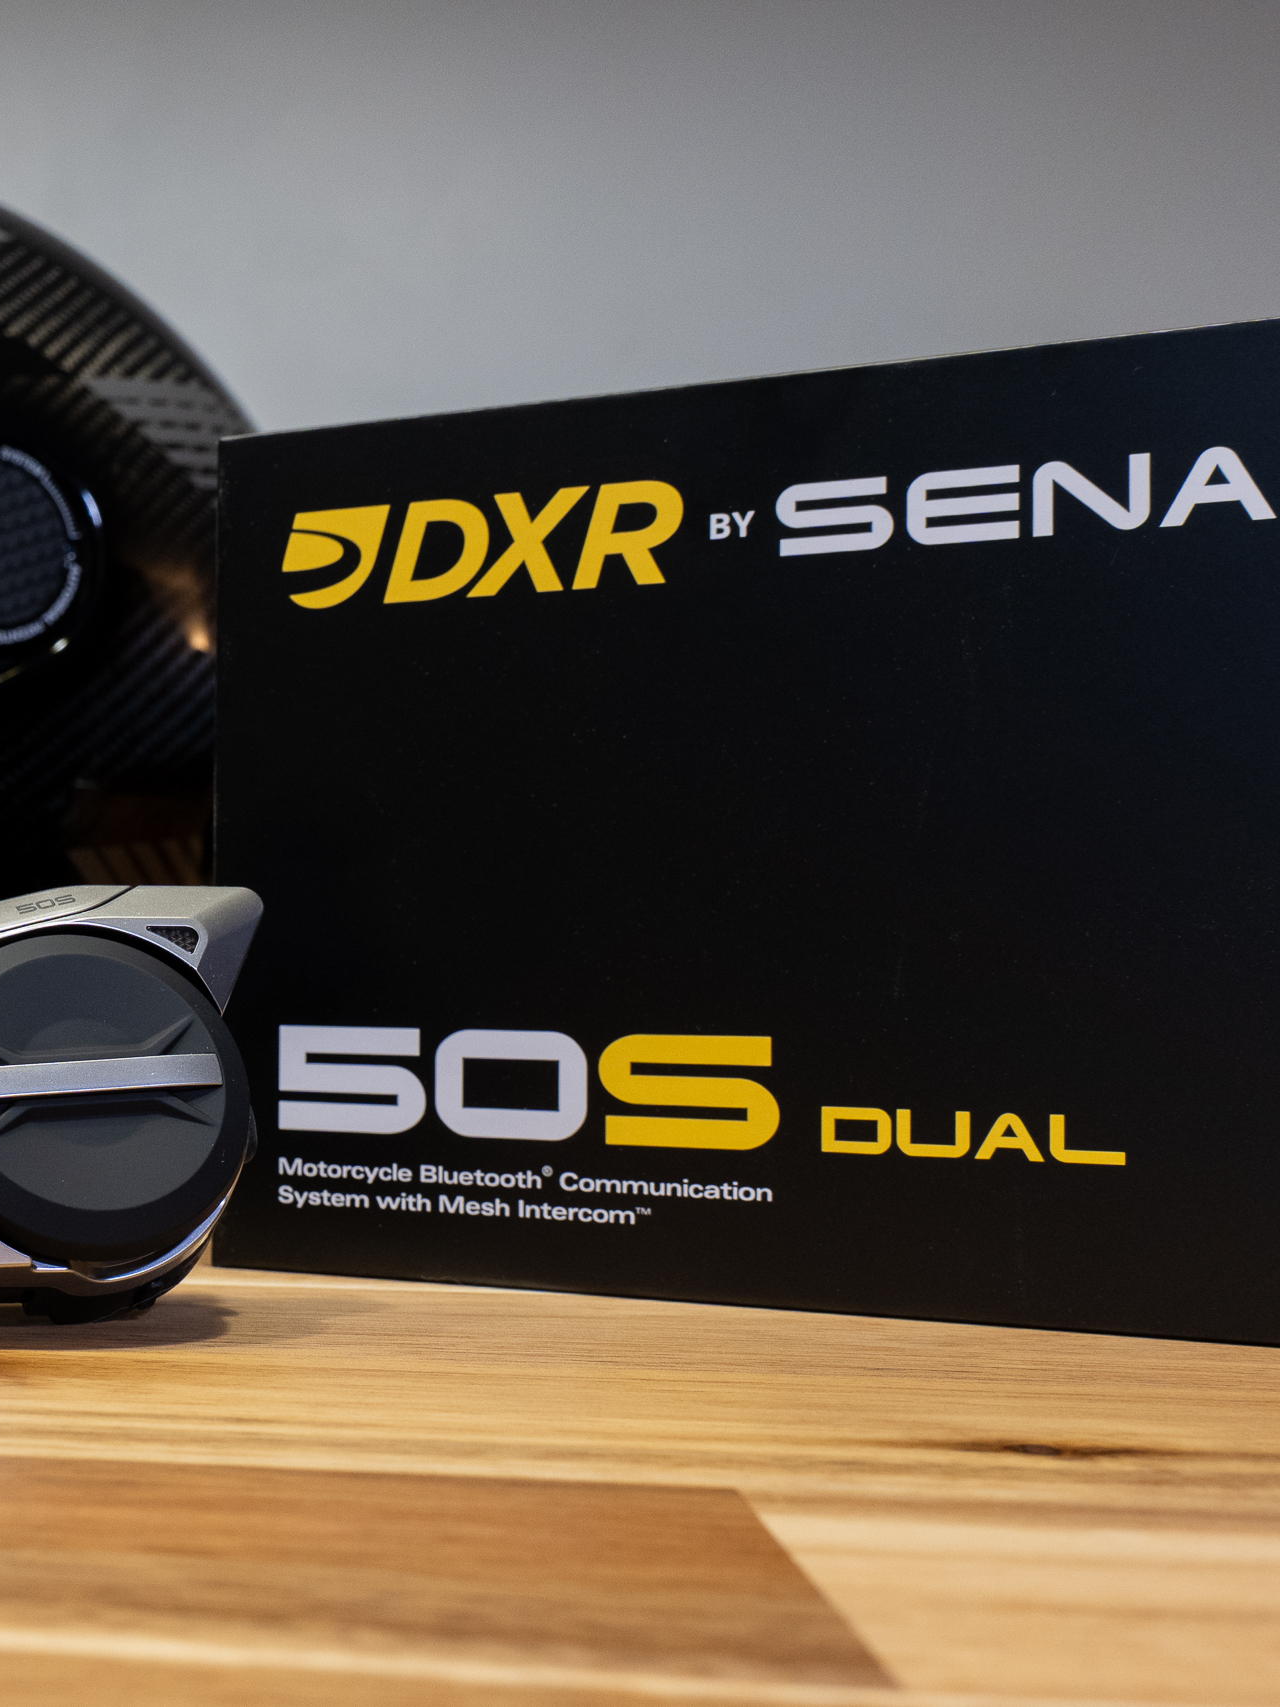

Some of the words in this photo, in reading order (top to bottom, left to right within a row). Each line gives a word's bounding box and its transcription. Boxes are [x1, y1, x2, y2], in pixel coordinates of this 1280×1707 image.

[382, 479, 684, 605] DXR
[709, 510, 756, 541] BY
[775, 446, 1278, 557] SENA
[15, 893, 77, 915] 50S
[277, 1024, 781, 1151] 50S
[821, 1105, 1127, 1166] DUAL
[277, 1156, 413, 1184] Motorcycle
[558, 1171, 774, 1203] Communication
[277, 1184, 371, 1209] System
[375, 1192, 432, 1213] with
[438, 1194, 511, 1218] Mesh
